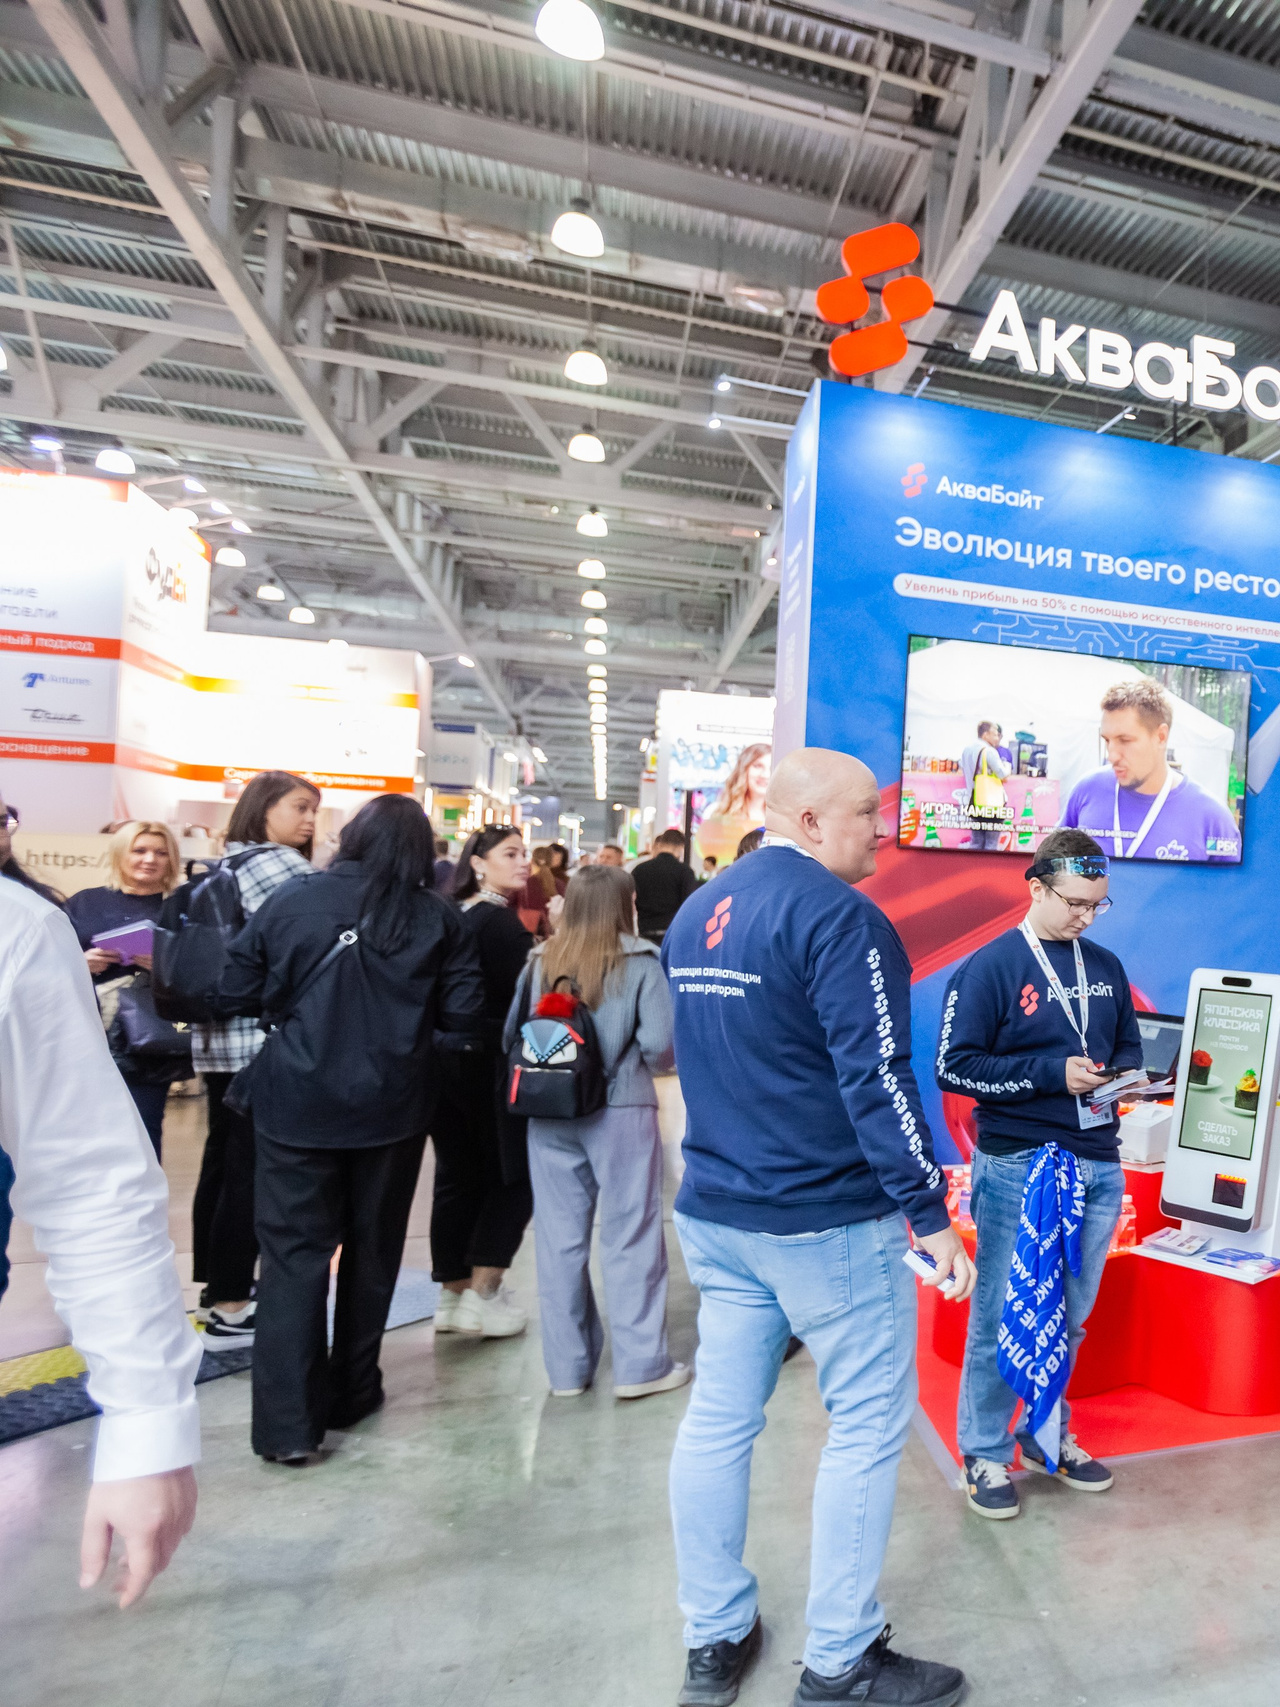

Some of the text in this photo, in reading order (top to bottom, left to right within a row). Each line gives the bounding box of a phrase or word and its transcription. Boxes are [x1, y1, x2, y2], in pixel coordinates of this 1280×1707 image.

[936, 475, 1043, 511] АкваБайт
[895, 516, 1073, 569] Эволюция
[1081, 550, 1186, 585] твоего
[905, 579, 958, 596] Увеличь
[963, 588, 1018, 604] прибыль
[1022, 598, 1038, 607] на
[1041, 597, 1067, 610] 50%
[1070, 604, 1077, 612] с
[1080, 605, 1138, 620] помощью
[1141, 613, 1233, 632] искусственного
[920, 801, 958, 816] ИГОРЬ
[981, 821, 993, 831] THE
[1216, 840, 1238, 851] РБК
[1203, 1003, 1264, 1020] ЯПОНСКАЯ
[1202, 1016, 1261, 1033] КЛАССИКА
[1197, 1120, 1238, 1136] СДЕЛАТЬ
[1202, 1132, 1231, 1147] ЗАКАЗ
